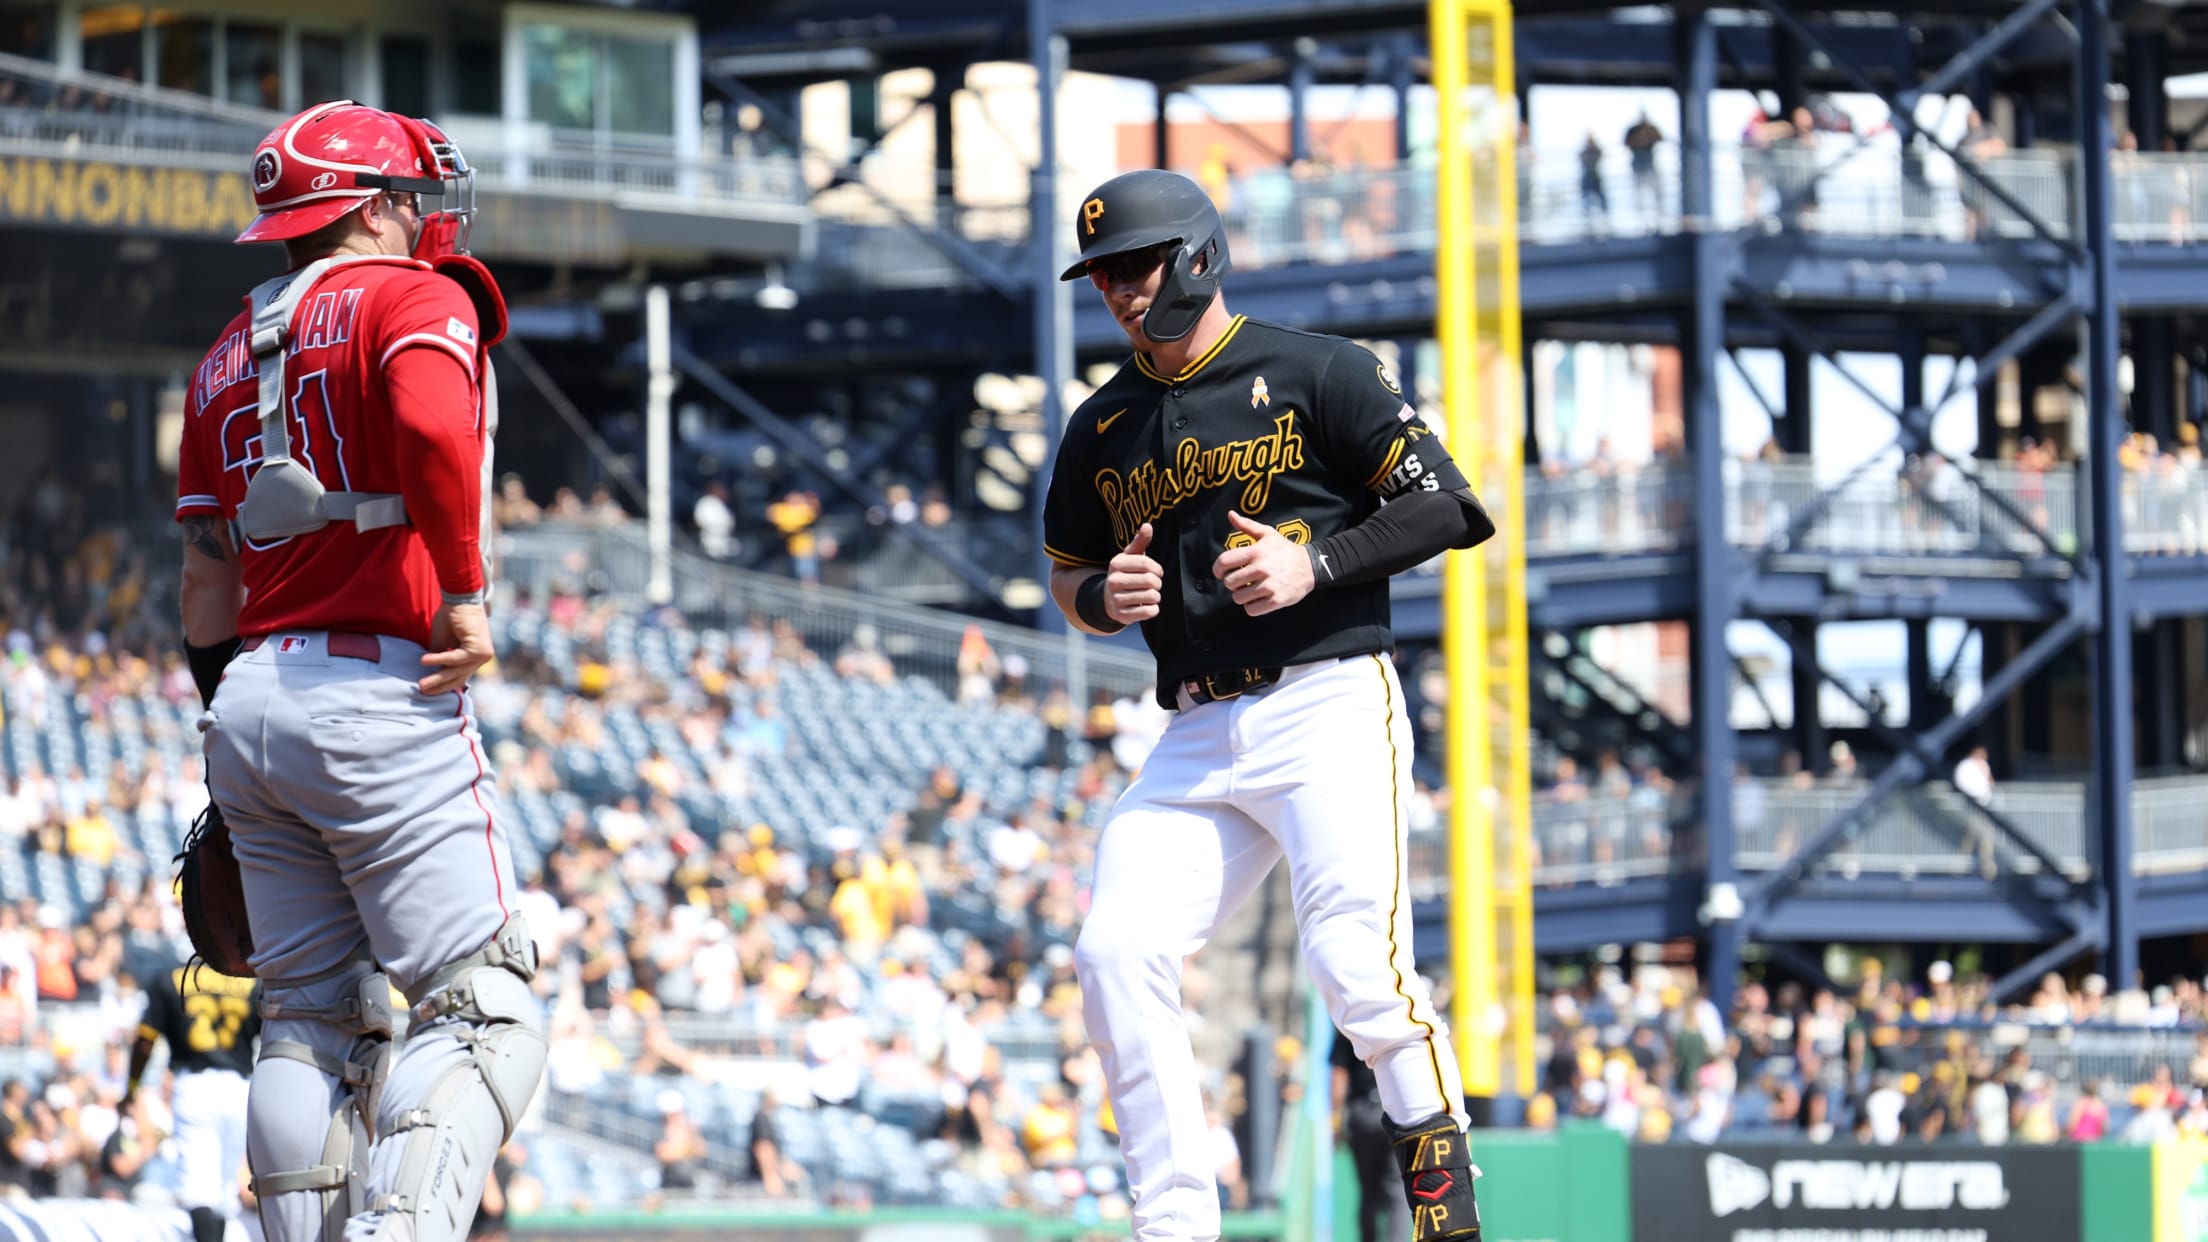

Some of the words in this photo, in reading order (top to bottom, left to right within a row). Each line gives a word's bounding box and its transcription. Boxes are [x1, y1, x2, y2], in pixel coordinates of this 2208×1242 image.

[1083, 198, 1105, 235] P
[1095, 409, 1304, 551] Pittsburgh
[1433, 1139, 1452, 1167] P
[1429, 1204, 1449, 1232] P
